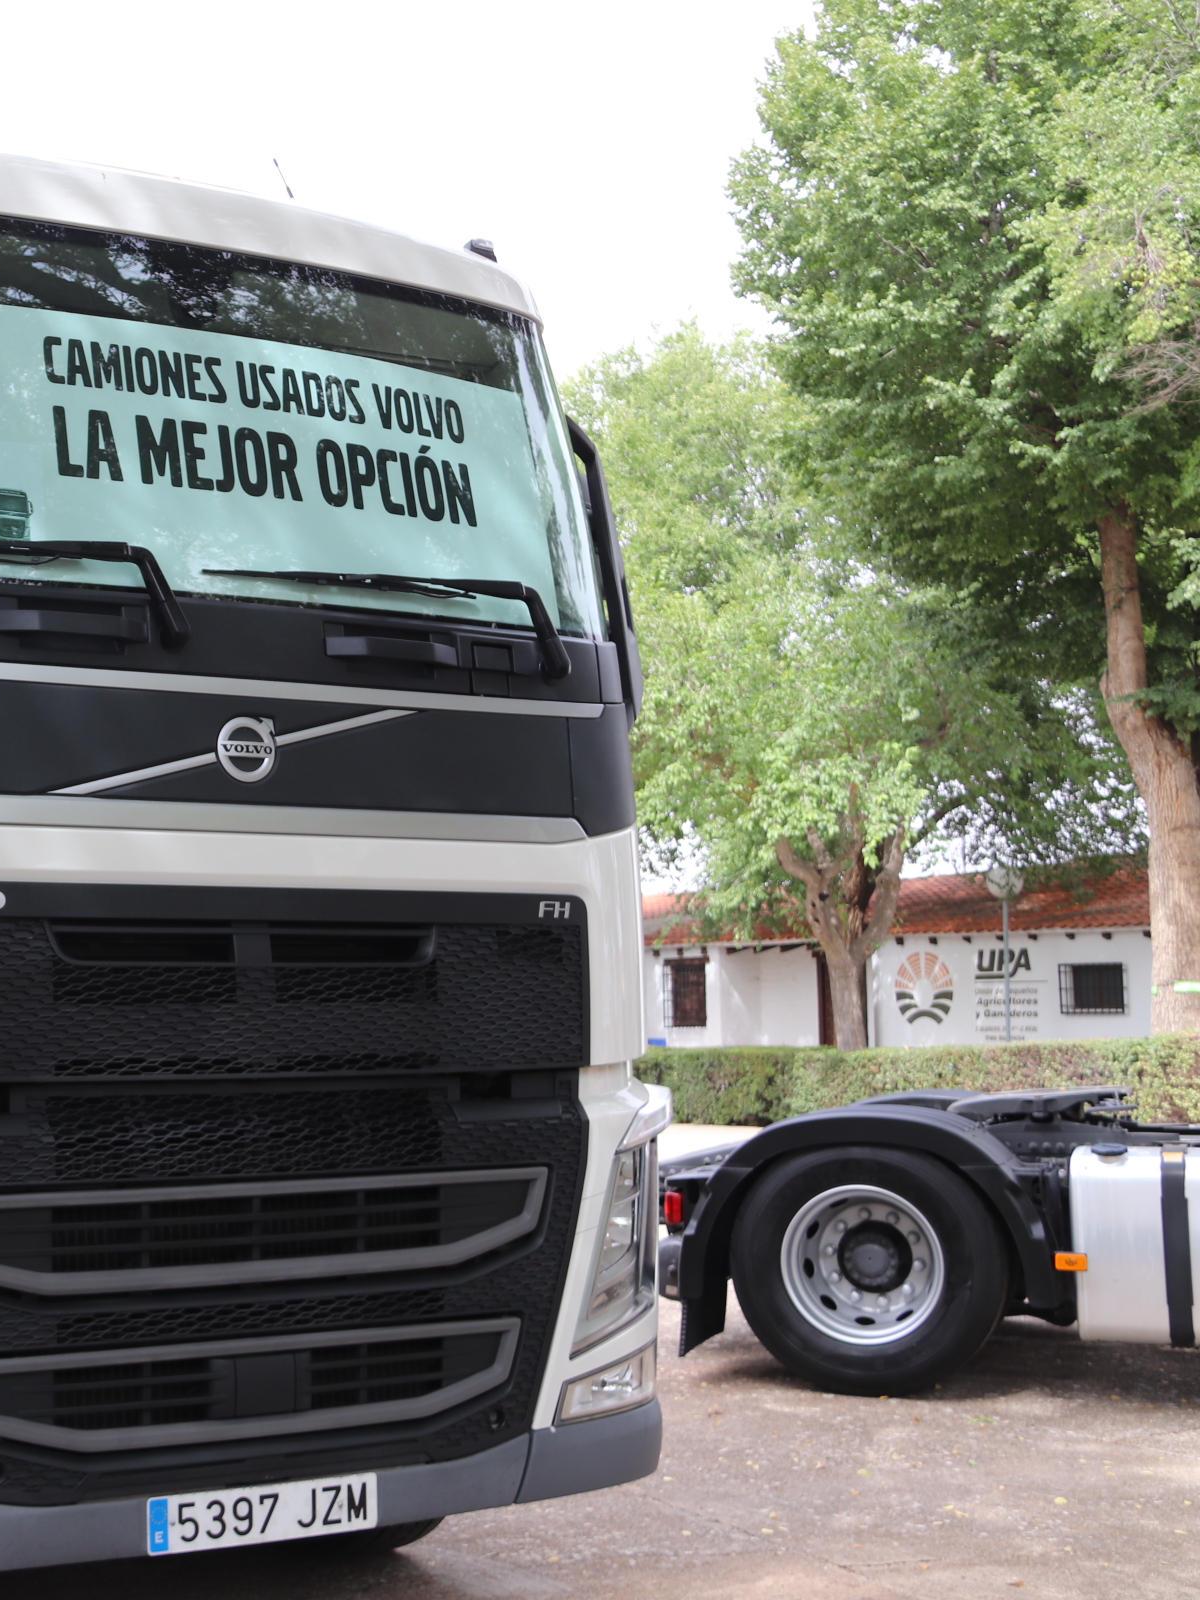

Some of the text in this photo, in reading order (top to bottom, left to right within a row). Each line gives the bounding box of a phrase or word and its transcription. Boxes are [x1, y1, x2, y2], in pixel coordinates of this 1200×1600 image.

[43, 335, 465, 444] CAMIONES USADOS VOLVO
[53, 405, 478, 527] LA MEJOR OPCIÓN
[220, 743, 273, 755] VOLVO
[538, 900, 571, 919] FH
[975, 947, 1032, 978] UPA
[1005, 986, 1038, 997] equeños
[983, 1008, 1039, 1018] Ganderos
[177, 1481, 368, 1542] 5397 JZM
[154, 1531, 164, 1544] E
